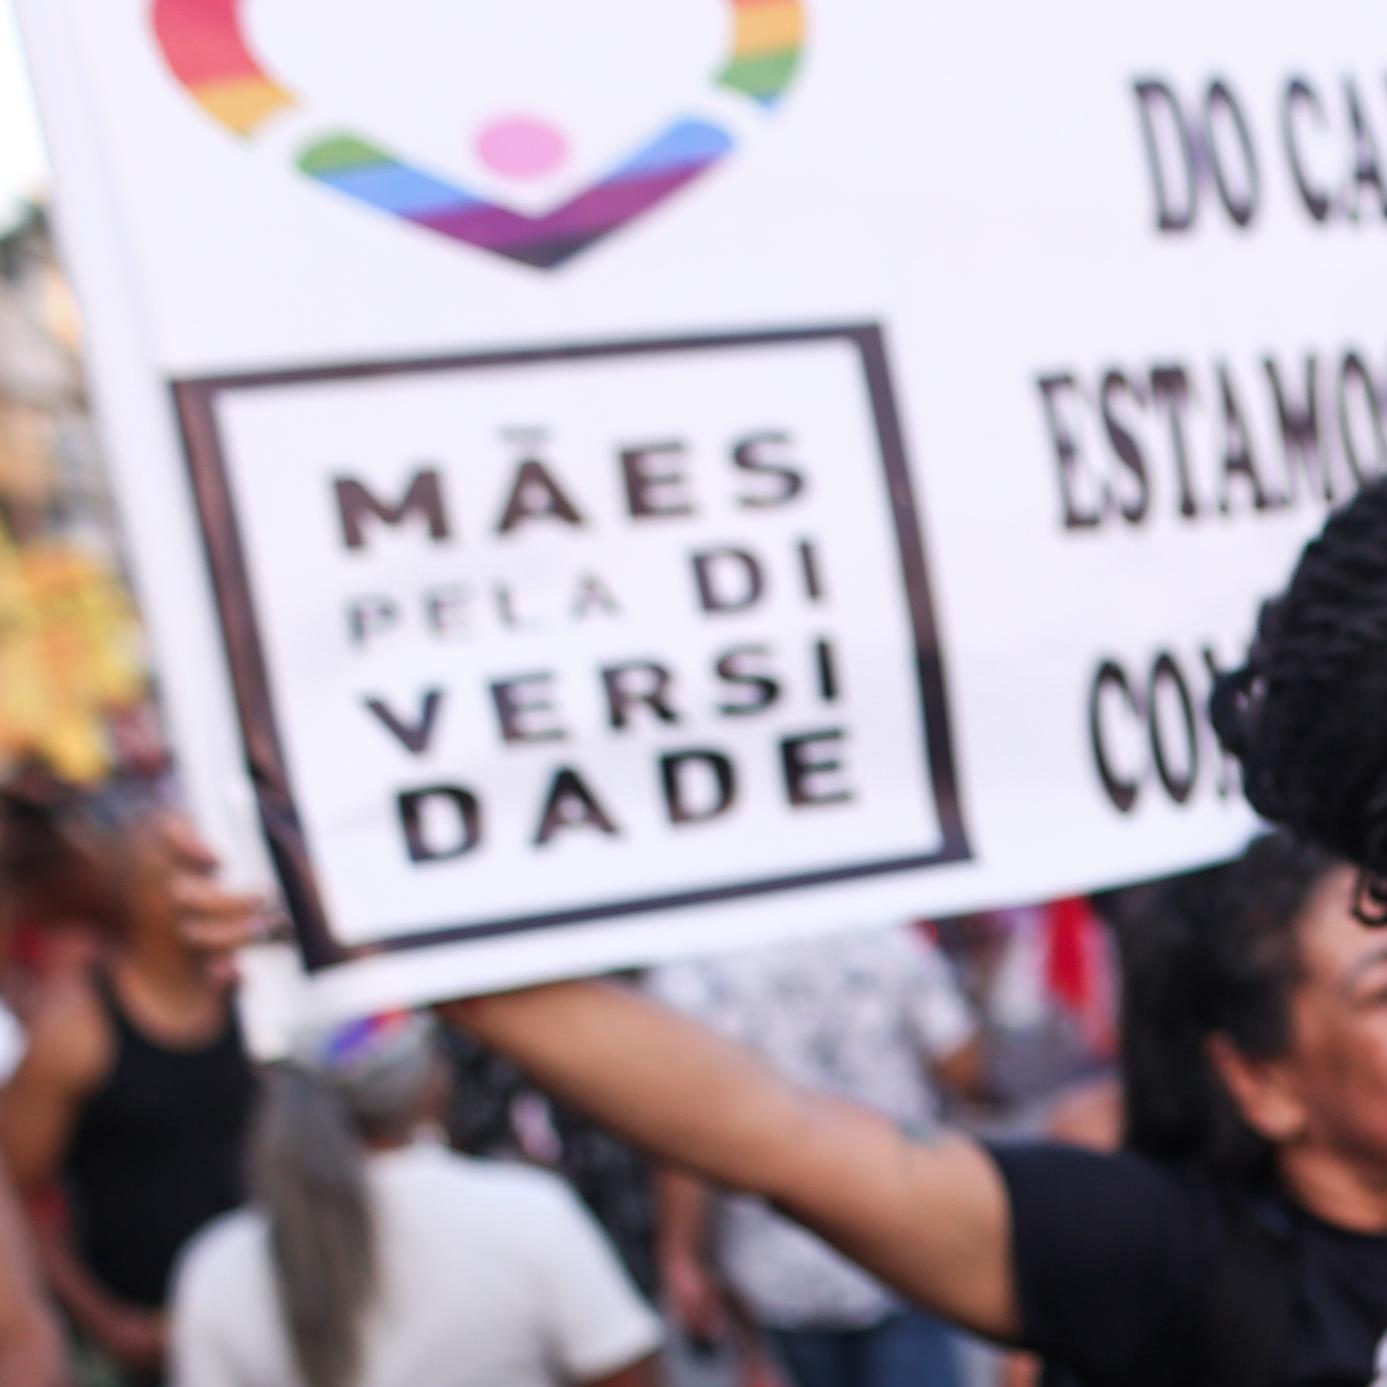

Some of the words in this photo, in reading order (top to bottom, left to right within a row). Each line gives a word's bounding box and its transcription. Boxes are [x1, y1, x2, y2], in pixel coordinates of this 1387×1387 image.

[1132, 74, 1262, 234] DO
[329, 426, 805, 553] MÃES
[348, 576, 620, 646] PELA
[691, 538, 826, 613] DI
[361, 638, 842, 758] VERSI
[1088, 645, 1242, 814] CO
[397, 730, 857, 865] DADE
